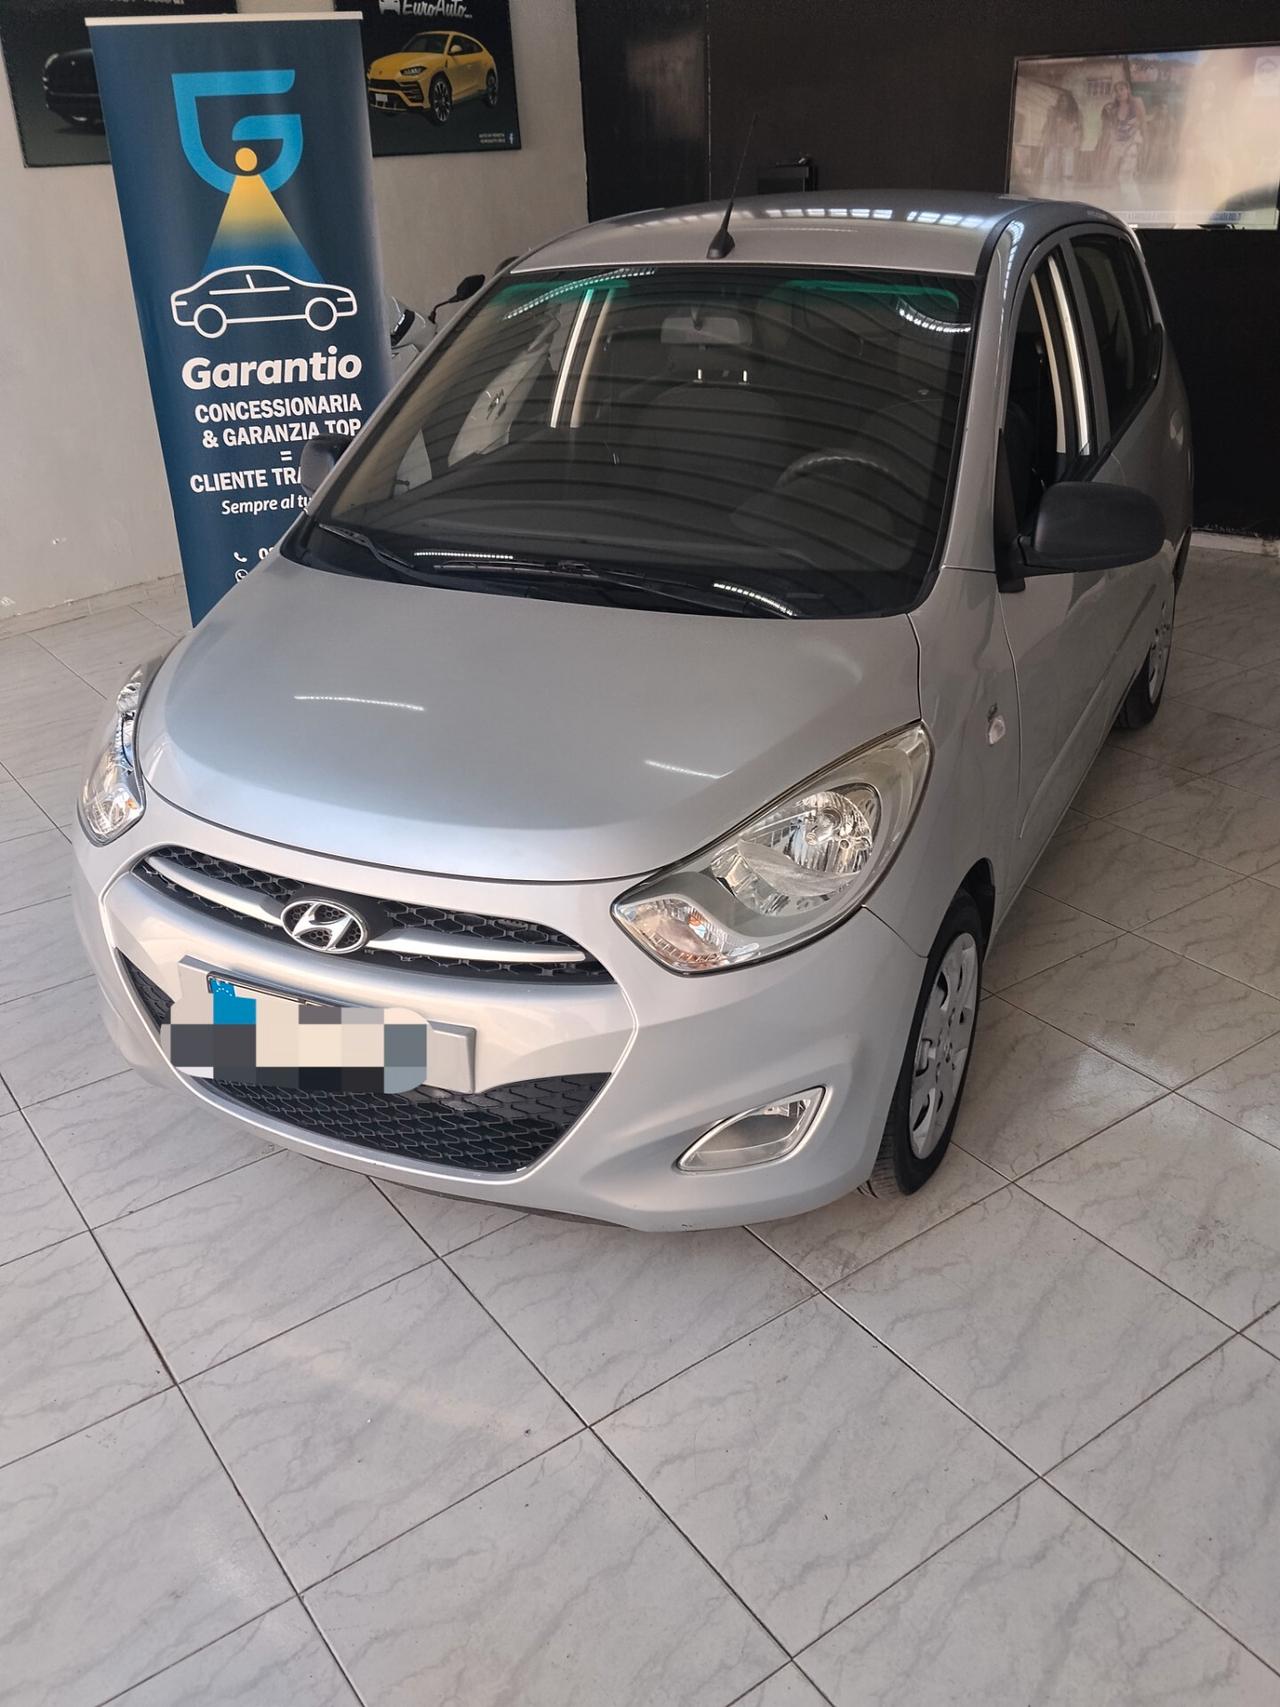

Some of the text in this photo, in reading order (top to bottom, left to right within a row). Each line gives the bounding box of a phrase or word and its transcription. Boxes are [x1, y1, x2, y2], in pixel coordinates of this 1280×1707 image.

[402, 0, 467, 16] EuroAuto
[181, 345, 363, 390] Garantio
[194, 393, 362, 423] CONCESSIONARIA
[202, 429, 219, 448] &
[222, 421, 320, 447] GARANZIA
[190, 469, 268, 493] CLIENTE
[221, 496, 278, 515] Sempre
[280, 493, 295, 509] al
